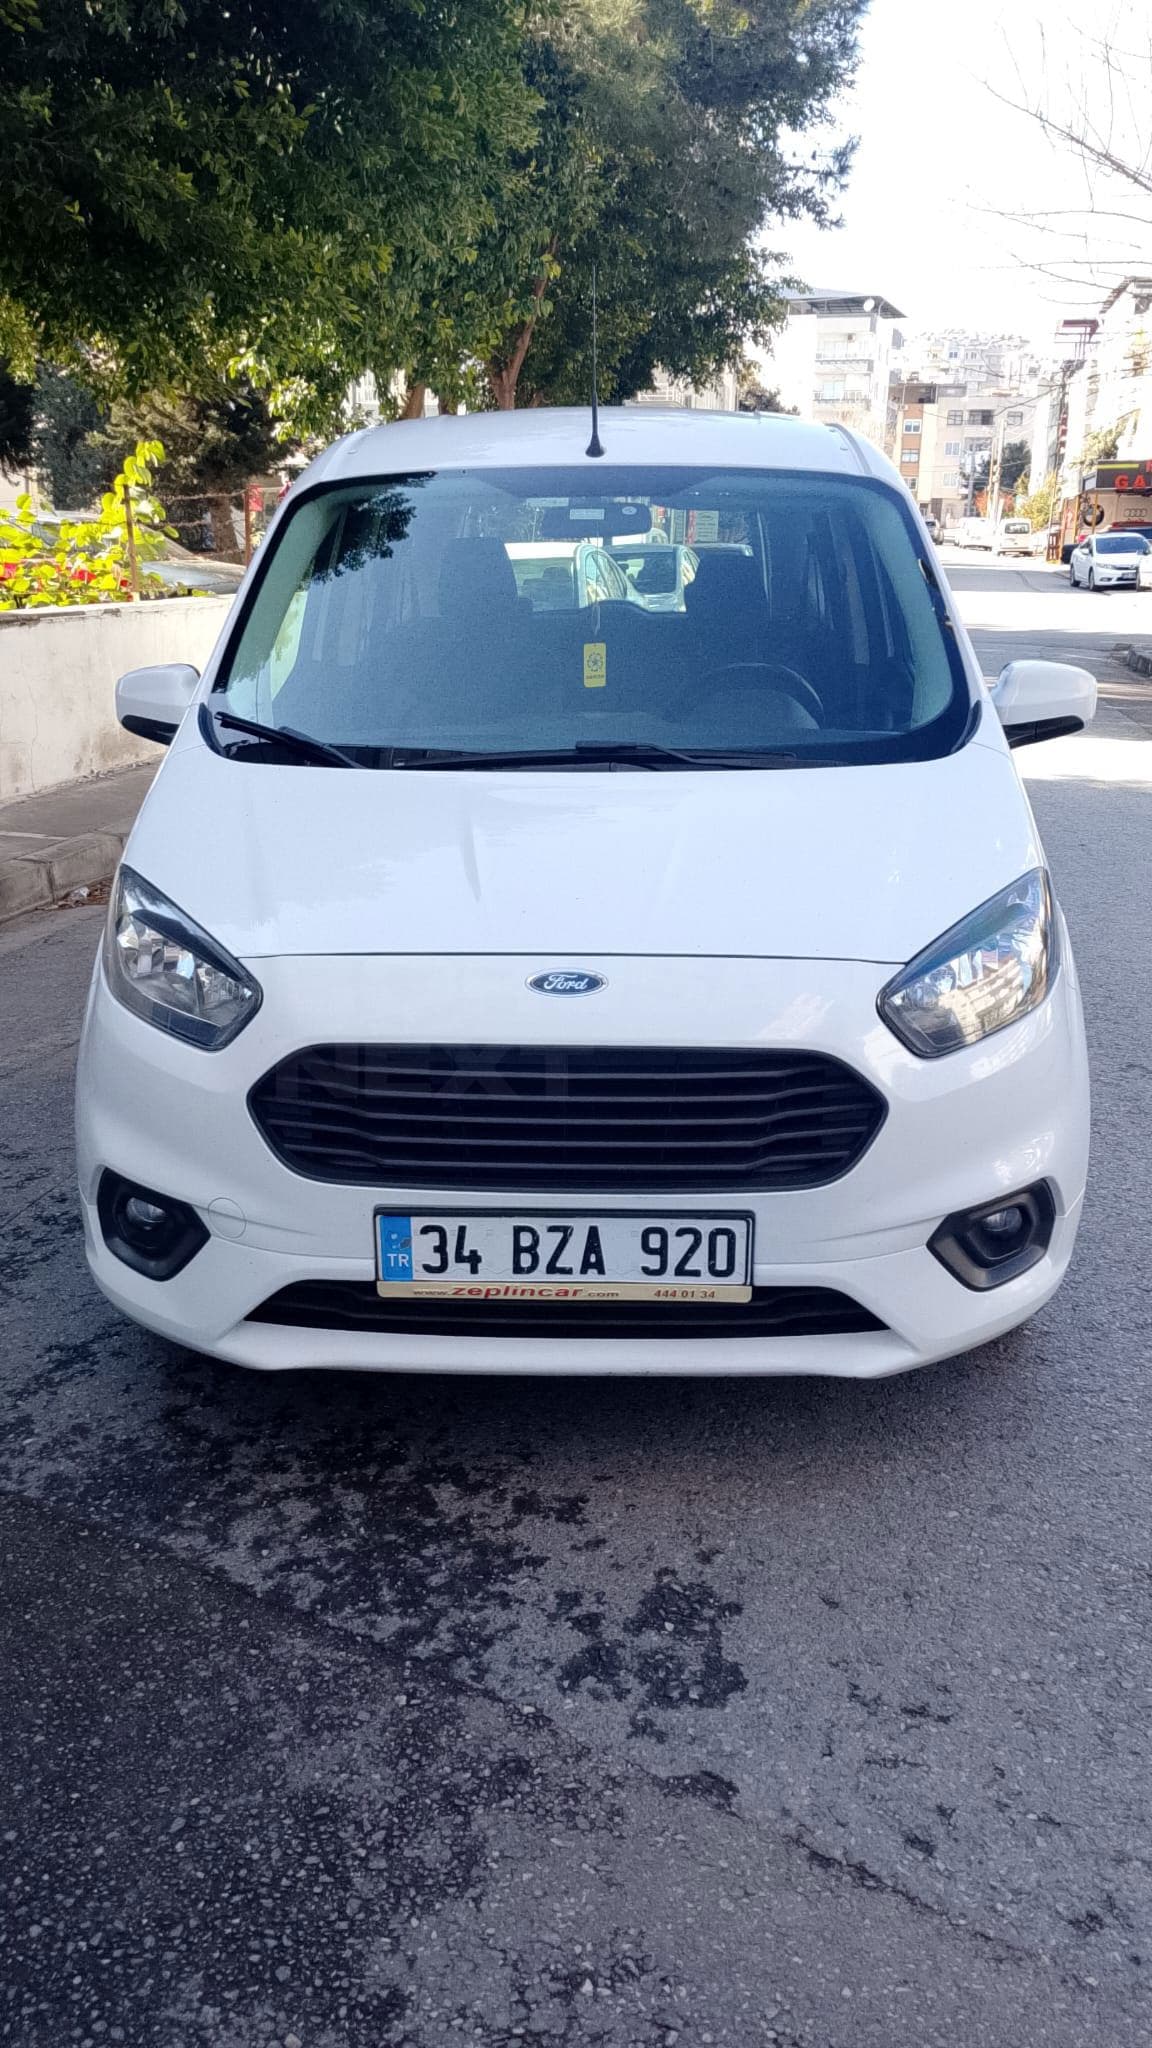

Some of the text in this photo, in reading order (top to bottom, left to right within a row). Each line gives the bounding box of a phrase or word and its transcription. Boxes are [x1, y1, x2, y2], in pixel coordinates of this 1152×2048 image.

[543, 974, 589, 990] Ford
[420, 1224, 737, 1278] 34 BZA 920
[387, 1253, 409, 1267] TR
[653, 1289, 677, 1299] 444
[681, 1289, 695, 1299] 01
[700, 1290, 716, 1299] 34
